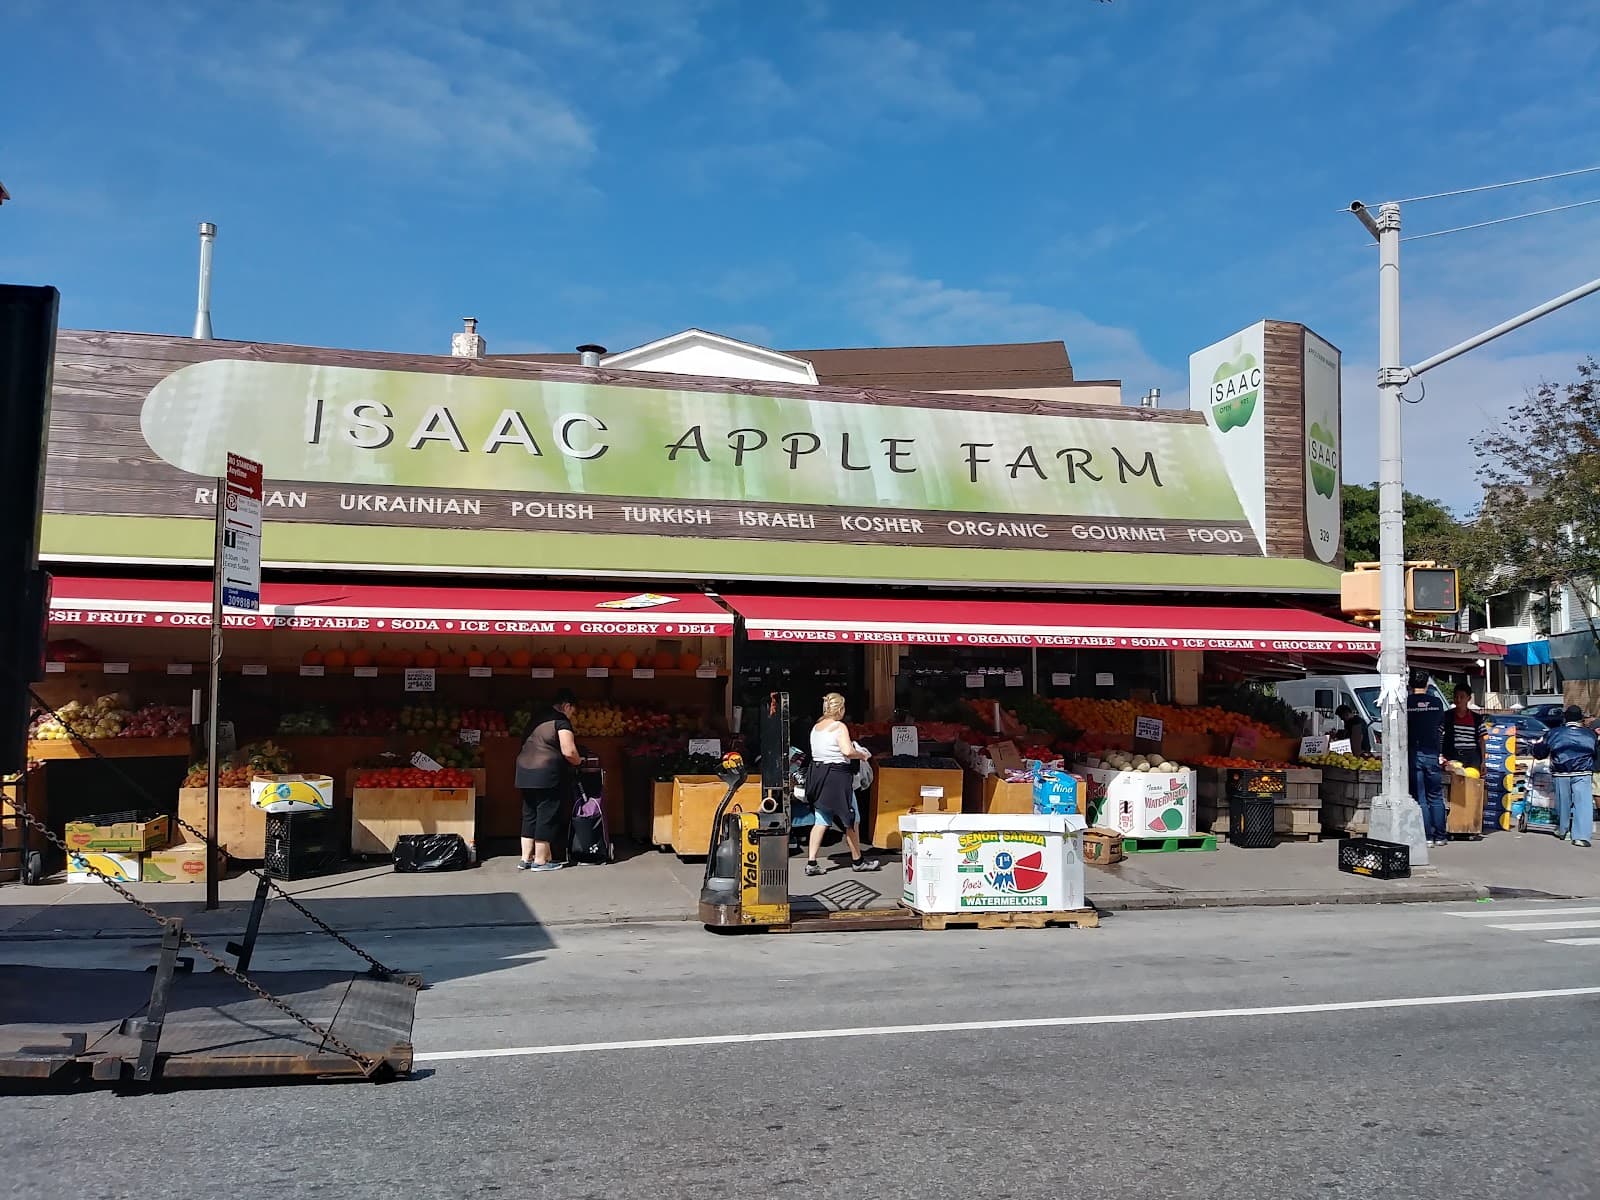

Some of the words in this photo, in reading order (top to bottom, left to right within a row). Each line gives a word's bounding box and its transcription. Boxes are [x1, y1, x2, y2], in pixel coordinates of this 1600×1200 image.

[1210, 368, 1261, 404] ISAAC
[306, 399, 609, 460] ISAAC
[664, 425, 917, 473] APPLE
[960, 443, 1164, 487] FARM
[228, 456, 236, 466] NO
[236, 457, 258, 473] STANDING
[1309, 439, 1337, 470] ISAAC
[228, 465, 248, 479] Anytime
[195, 487, 306, 508] RIAN
[339, 494, 481, 515] UKRAINIAN
[511, 502, 593, 520] POLISH
[621, 506, 711, 525] TURKISH
[738, 511, 816, 529] ISRAELI
[840, 515, 923, 534] KOSHER
[947, 520, 1048, 539] ORGANIC
[1071, 525, 1166, 542] GOURMET
[1187, 528, 1244, 544] FOOD
[1318, 528, 1330, 543] 329
[87, 611, 147, 624] FRUIT
[169, 614, 257, 627] ORGNIC
[260, 615, 370, 629] VEGETABLE
[391, 618, 439, 630] SODA
[460, 620, 490, 632] ICE
[492, 620, 555, 633] CREAM
[580, 623, 660, 634] GROCERY
[678, 623, 716, 634] DELI
[763, 629, 836, 641] FLOWERS
[854, 631, 904, 642] FRESH
[907, 633, 951, 644] FRUIT
[967, 633, 1032, 645] ORGANIC
[1035, 635, 1116, 647] VEGETABLE
[1131, 638, 1169, 648] SODA
[1182, 638, 1206, 649] ICE
[1208, 638, 1255, 650] CREAM
[1272, 640, 1333, 651] GROCERY
[1347, 641, 1377, 651] DELI
[1052, 783, 1073, 793] Nina
[743, 850, 758, 890] Yale
[961, 878, 982, 894] Joe's
[966, 896, 1043, 906] WATERMELONS
